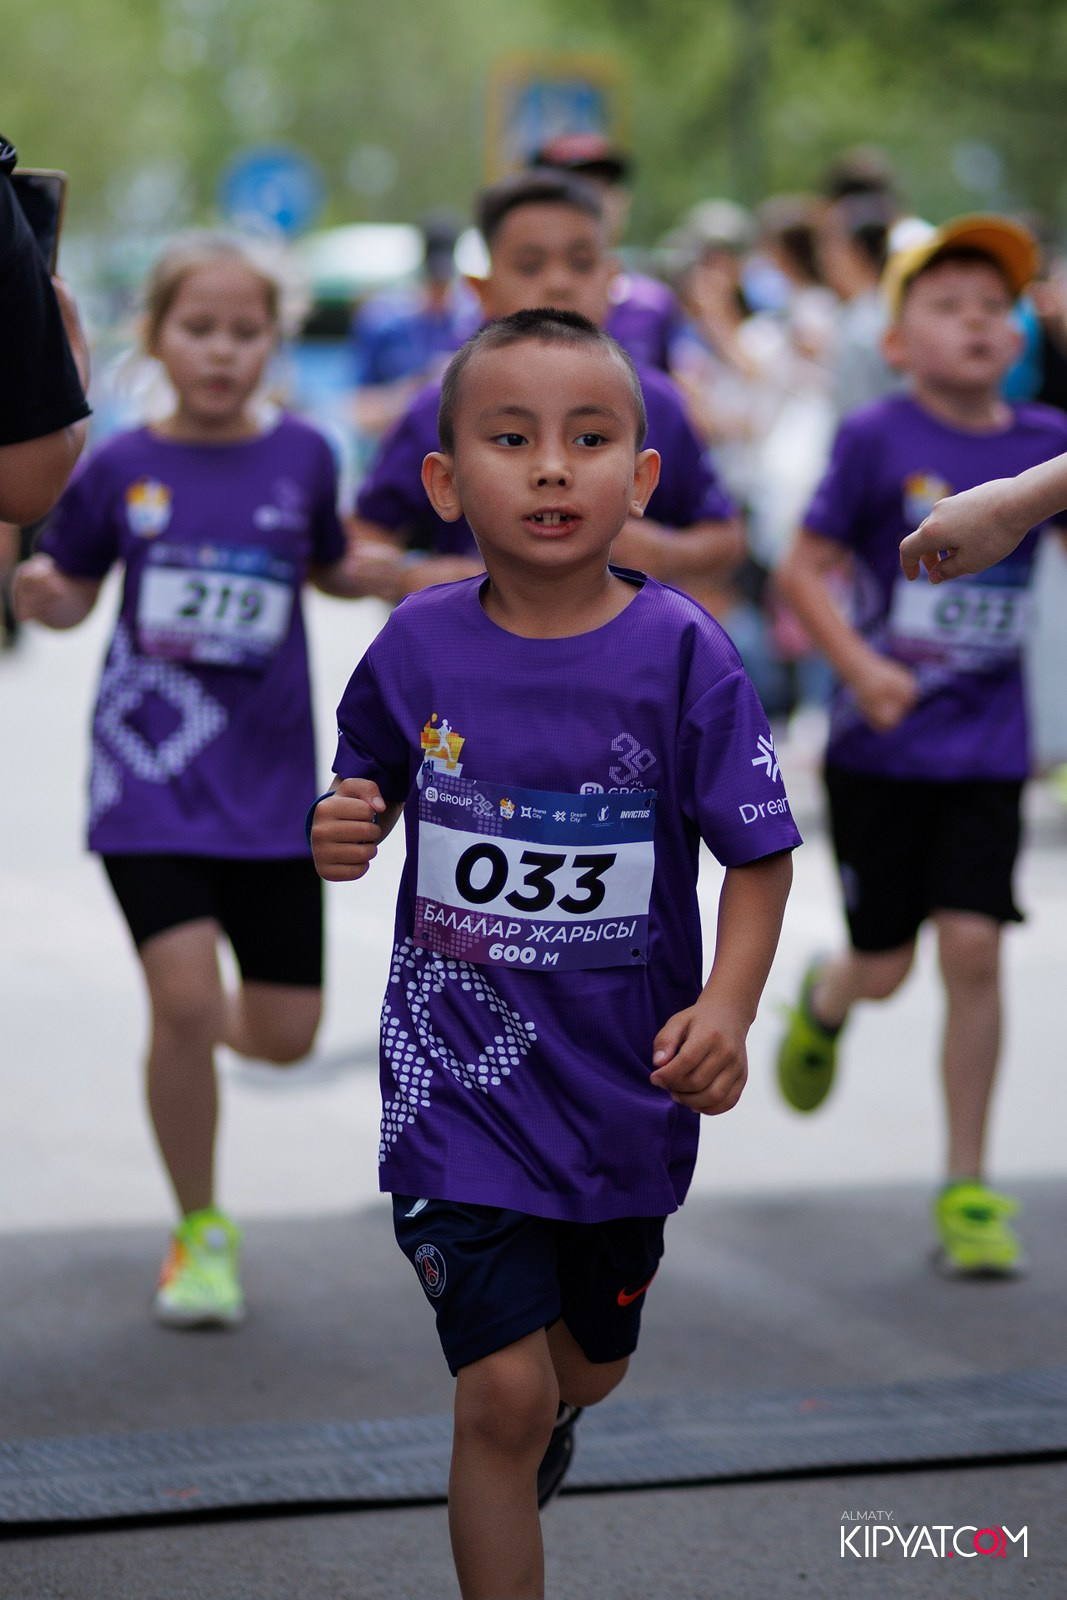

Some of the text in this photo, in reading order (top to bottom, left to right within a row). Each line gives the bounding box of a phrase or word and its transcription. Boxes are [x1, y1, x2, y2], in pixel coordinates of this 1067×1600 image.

[179, 581, 265, 626] 219
[439, 792, 473, 807] GROUP
[620, 810, 651, 819] INVICTUS
[455, 842, 618, 915] 033
[423, 902, 637, 944] БАЛАЛАР ЖАРЫСЫ
[488, 943, 537, 965] 600
